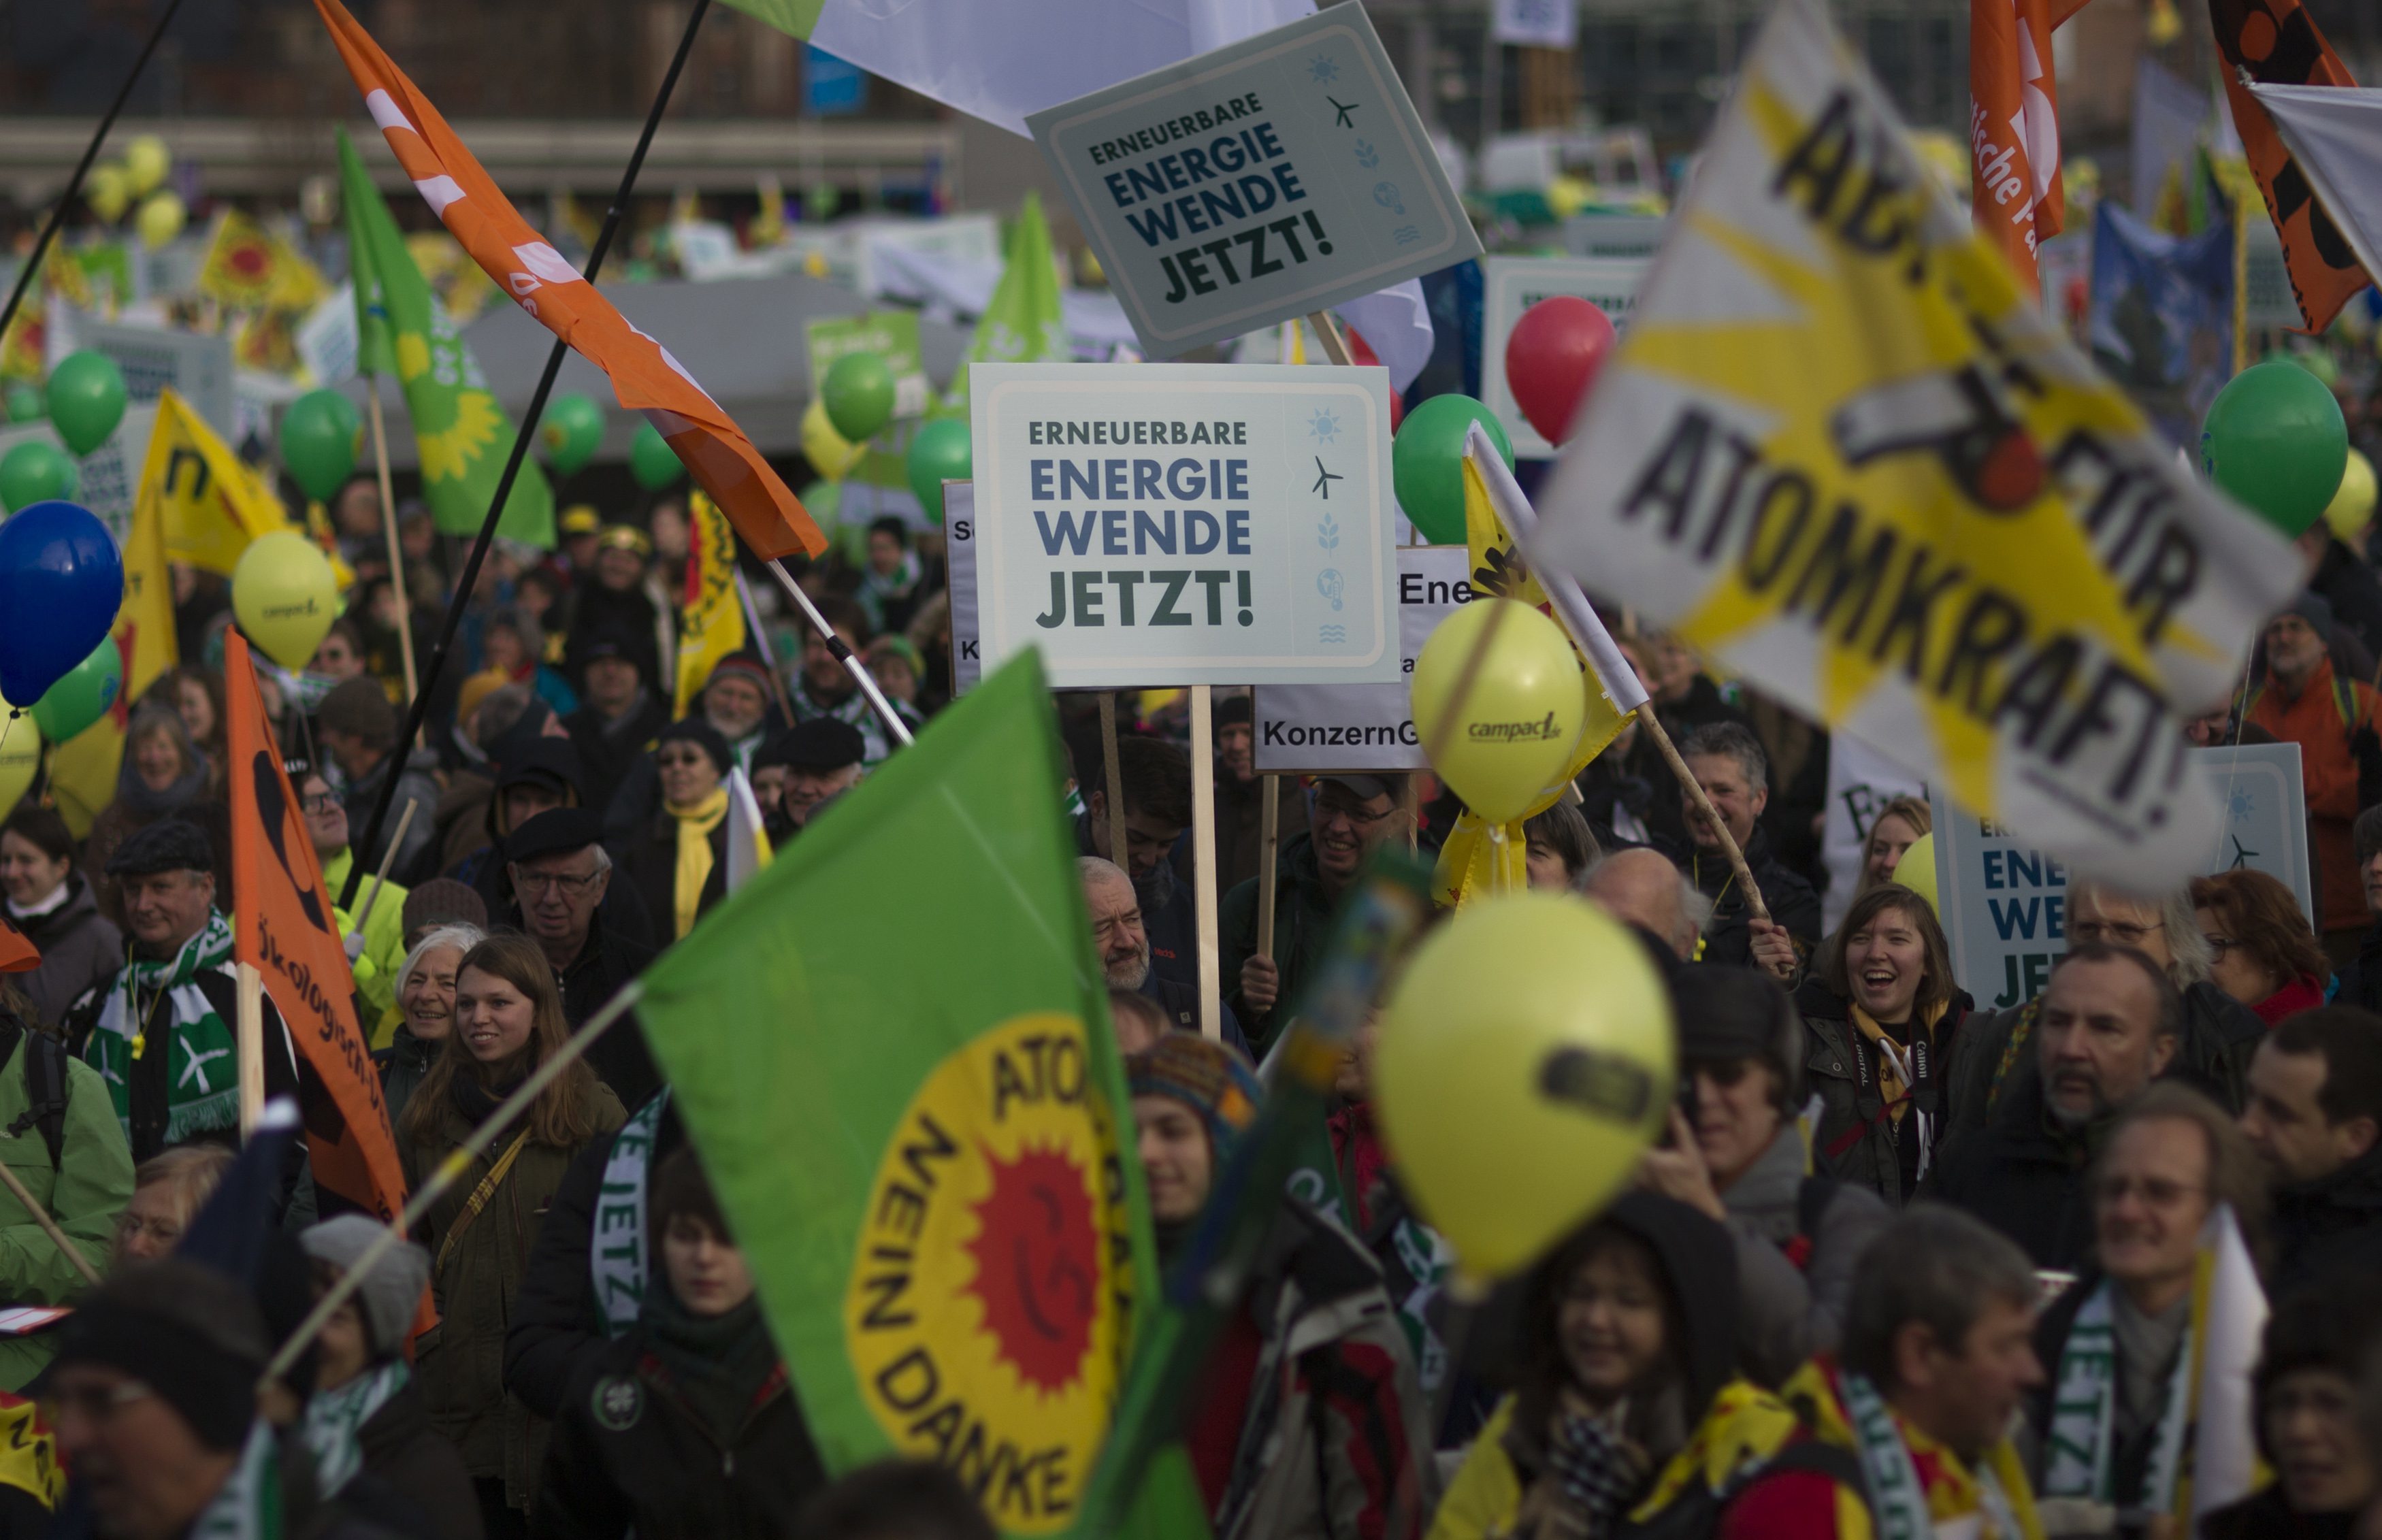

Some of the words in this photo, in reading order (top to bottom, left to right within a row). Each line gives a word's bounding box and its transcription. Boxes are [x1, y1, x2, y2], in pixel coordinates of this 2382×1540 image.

[1088, 92, 1262, 166] ERNEUERBARE
[1103, 122, 1285, 208] ENERGIE
[1125, 161, 1307, 248] WENDE
[1158, 208, 1333, 304] JETZT!
[1029, 421, 1247, 445] ERNEUERBARE
[1030, 458, 1249, 501] ENERGIE
[1034, 510, 1251, 556] WENDE
[1035, 570, 1254, 629] JETZT!
[1622, 410, 2182, 825] ATOMKRAFT!
[1264, 720, 1420, 746] KonzernG
[1856, 1044, 1869, 1087] DIGITAL
[1916, 1041, 1927, 1079] Canon
[860, 1111, 961, 1332] NEIN
[875, 1346, 1073, 1521] DANKE
